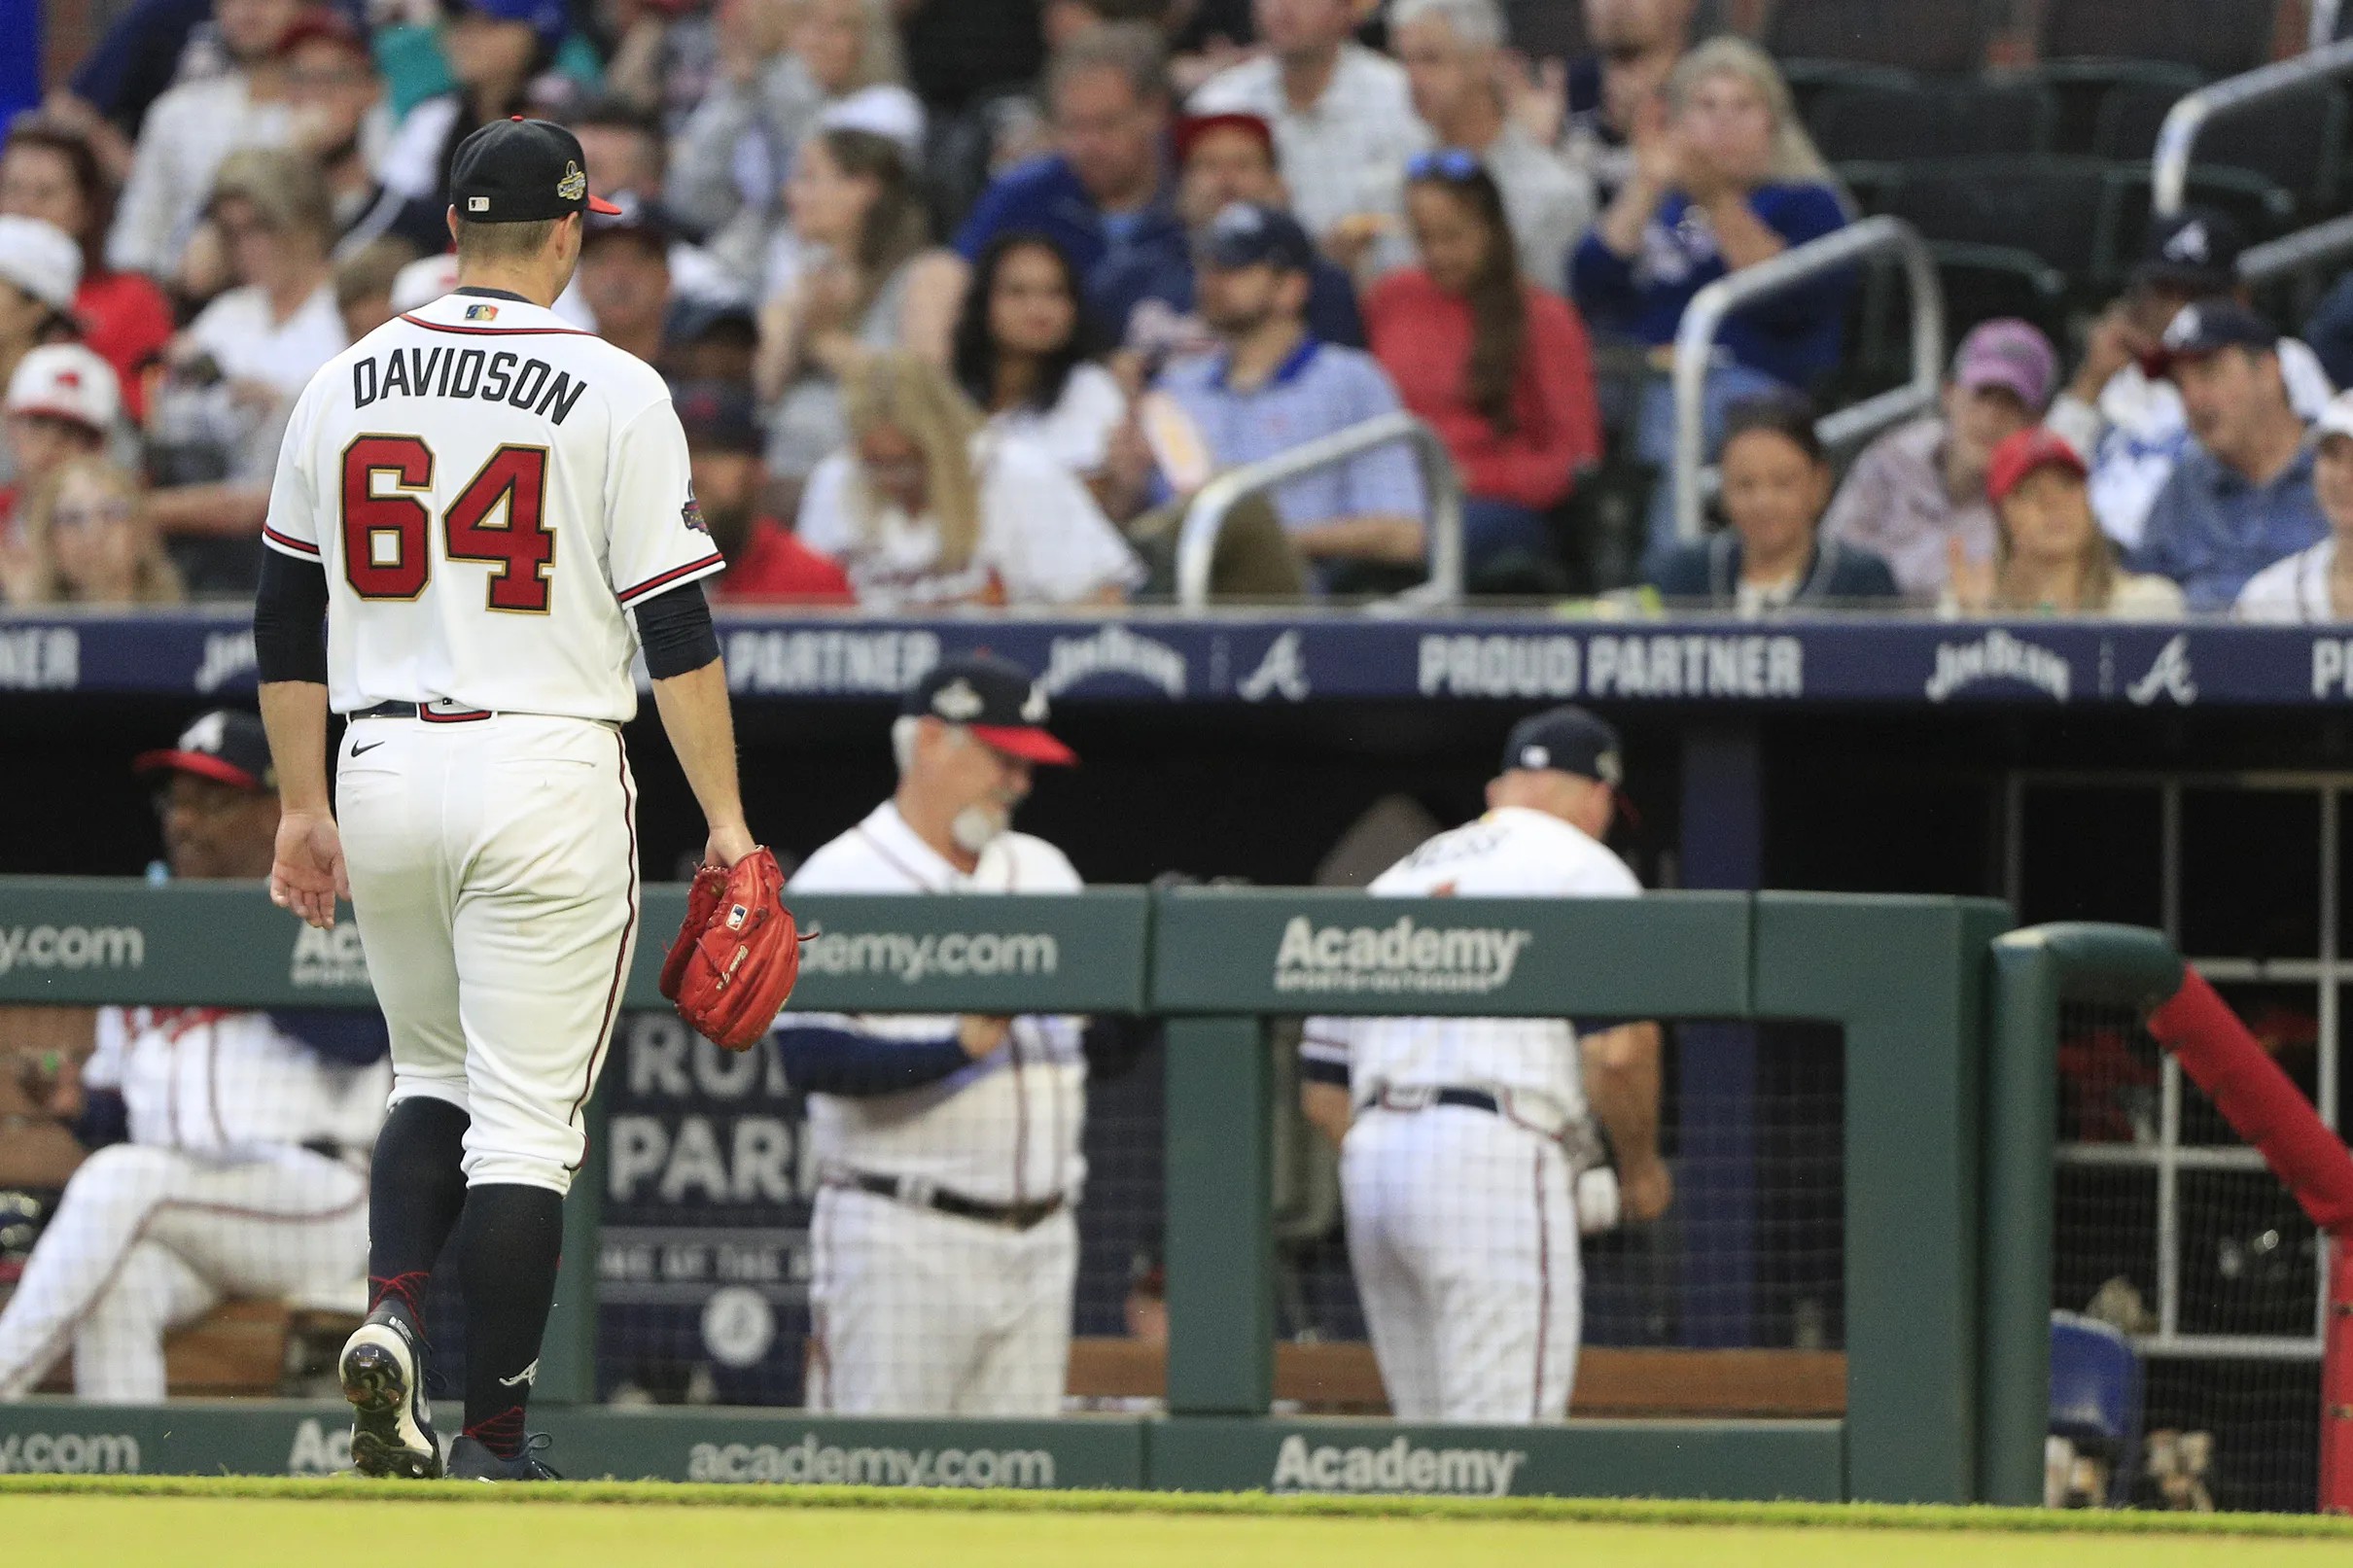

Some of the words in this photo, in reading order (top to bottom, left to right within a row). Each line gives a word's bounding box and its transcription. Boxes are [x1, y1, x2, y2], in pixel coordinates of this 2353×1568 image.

[353, 346, 587, 427] DAVIDSON
[339, 432, 557, 615] 64
[728, 630, 939, 694] PARTNER
[1418, 634, 1580, 698] PROUD
[1587, 635, 1804, 699] PARTNER
[1275, 915, 1527, 986] Academy
[688, 1433, 1054, 1487] academy.com
[1272, 1434, 1520, 1498] Academy
